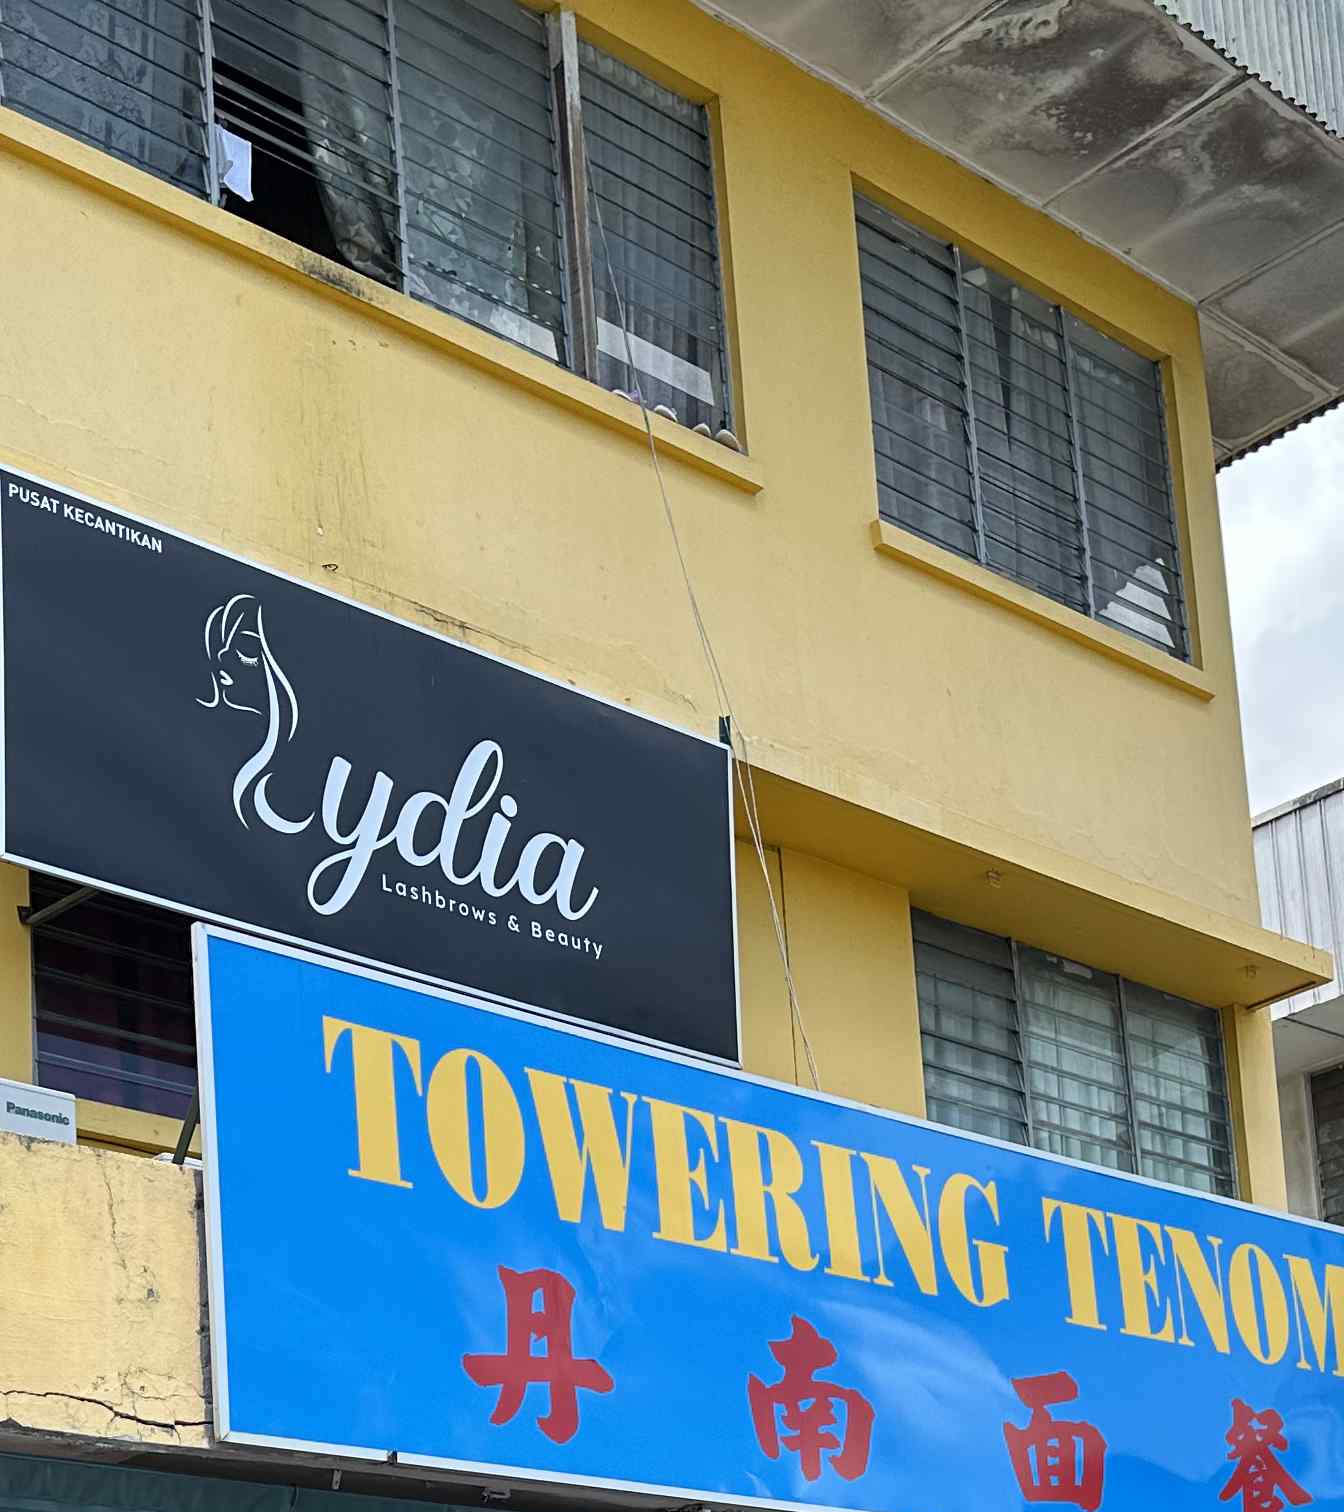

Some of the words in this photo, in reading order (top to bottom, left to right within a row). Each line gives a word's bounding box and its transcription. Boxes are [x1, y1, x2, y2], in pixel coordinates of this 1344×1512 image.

[8, 483, 59, 514] PUSAT
[63, 503, 162, 553] KECANTIKAN
[382, 873, 497, 925] Lashbrows
[507, 915, 521, 933] &
[531, 921, 603, 960] Beauty
[6, 1101, 70, 1126] Panasonic
[322, 1015, 1009, 1309] TOWERING
